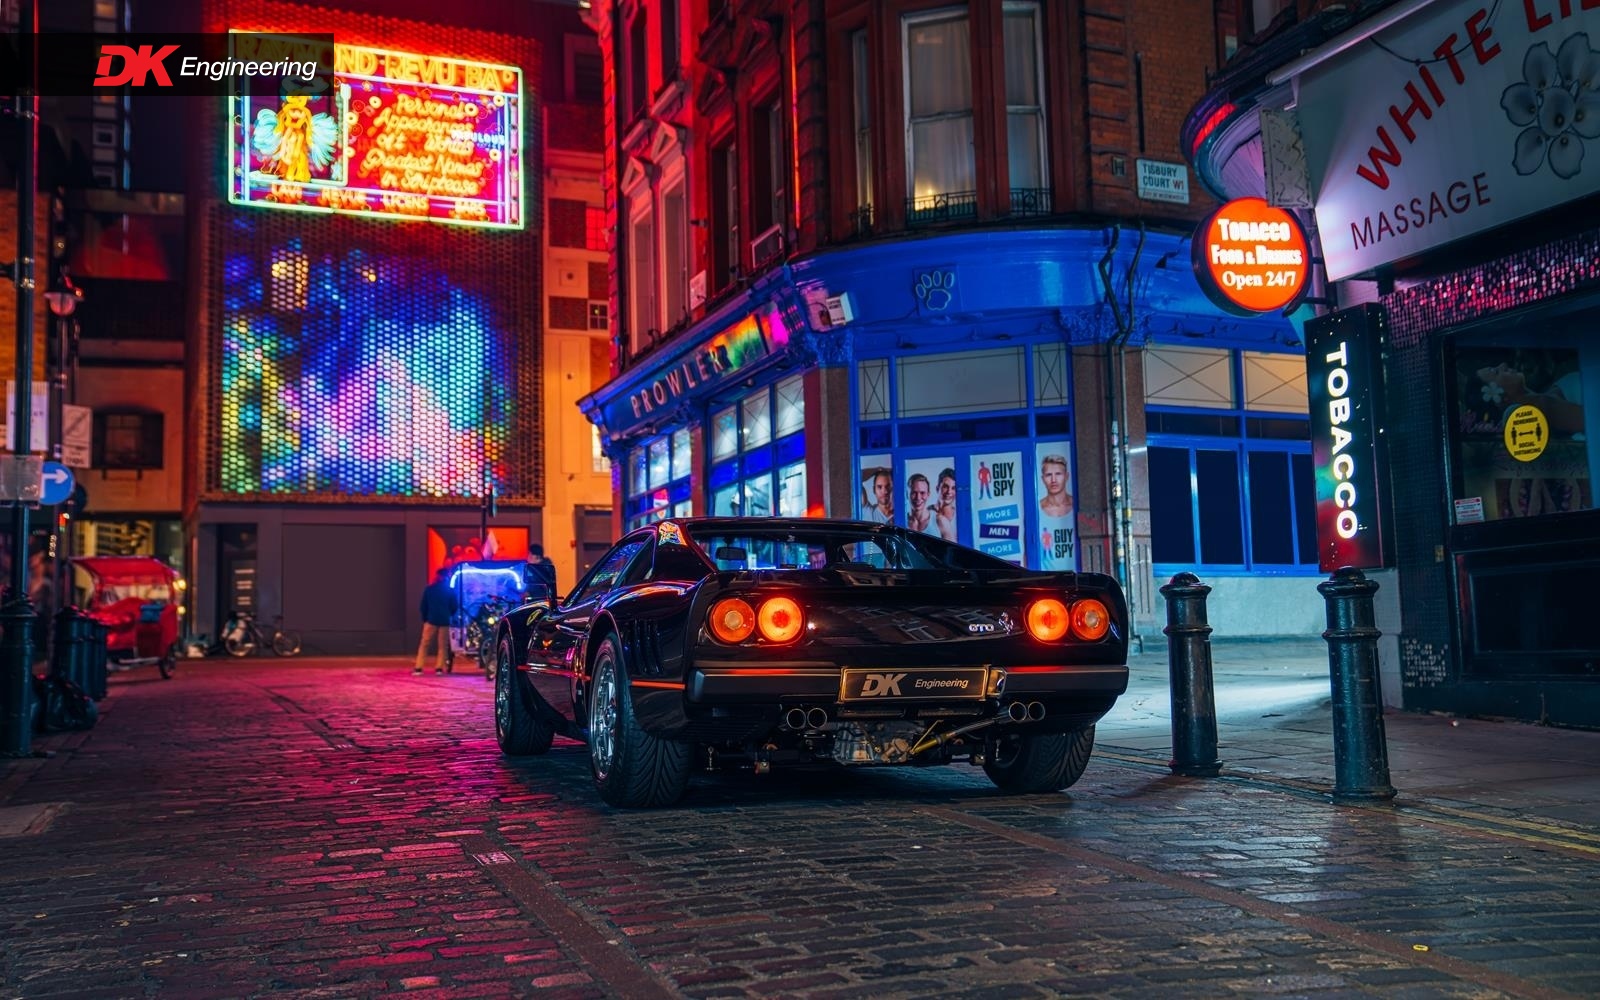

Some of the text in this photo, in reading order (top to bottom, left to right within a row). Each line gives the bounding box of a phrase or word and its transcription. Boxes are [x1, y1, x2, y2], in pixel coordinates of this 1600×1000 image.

[396, 93, 466, 119] Personal
[1356, 8, 1502, 190] WHITE
[1143, 163, 1177, 178] TISBURY
[1143, 175, 1184, 190] COURT W1
[1351, 172, 1491, 250] MASSAGE
[1222, 271, 1297, 290] Open 24/7
[1326, 341, 1358, 539] TOBACCO
[992, 462, 1014, 479] GUY
[993, 480, 1015, 497] SPY
[986, 510, 1011, 520] MORE
[988, 527, 1010, 537] MEN
[1054, 528, 1074, 543] GUY
[1055, 544, 1074, 559] SPY
[969, 623, 994, 632] GTO
[860, 673, 969, 697] DK Engineering
